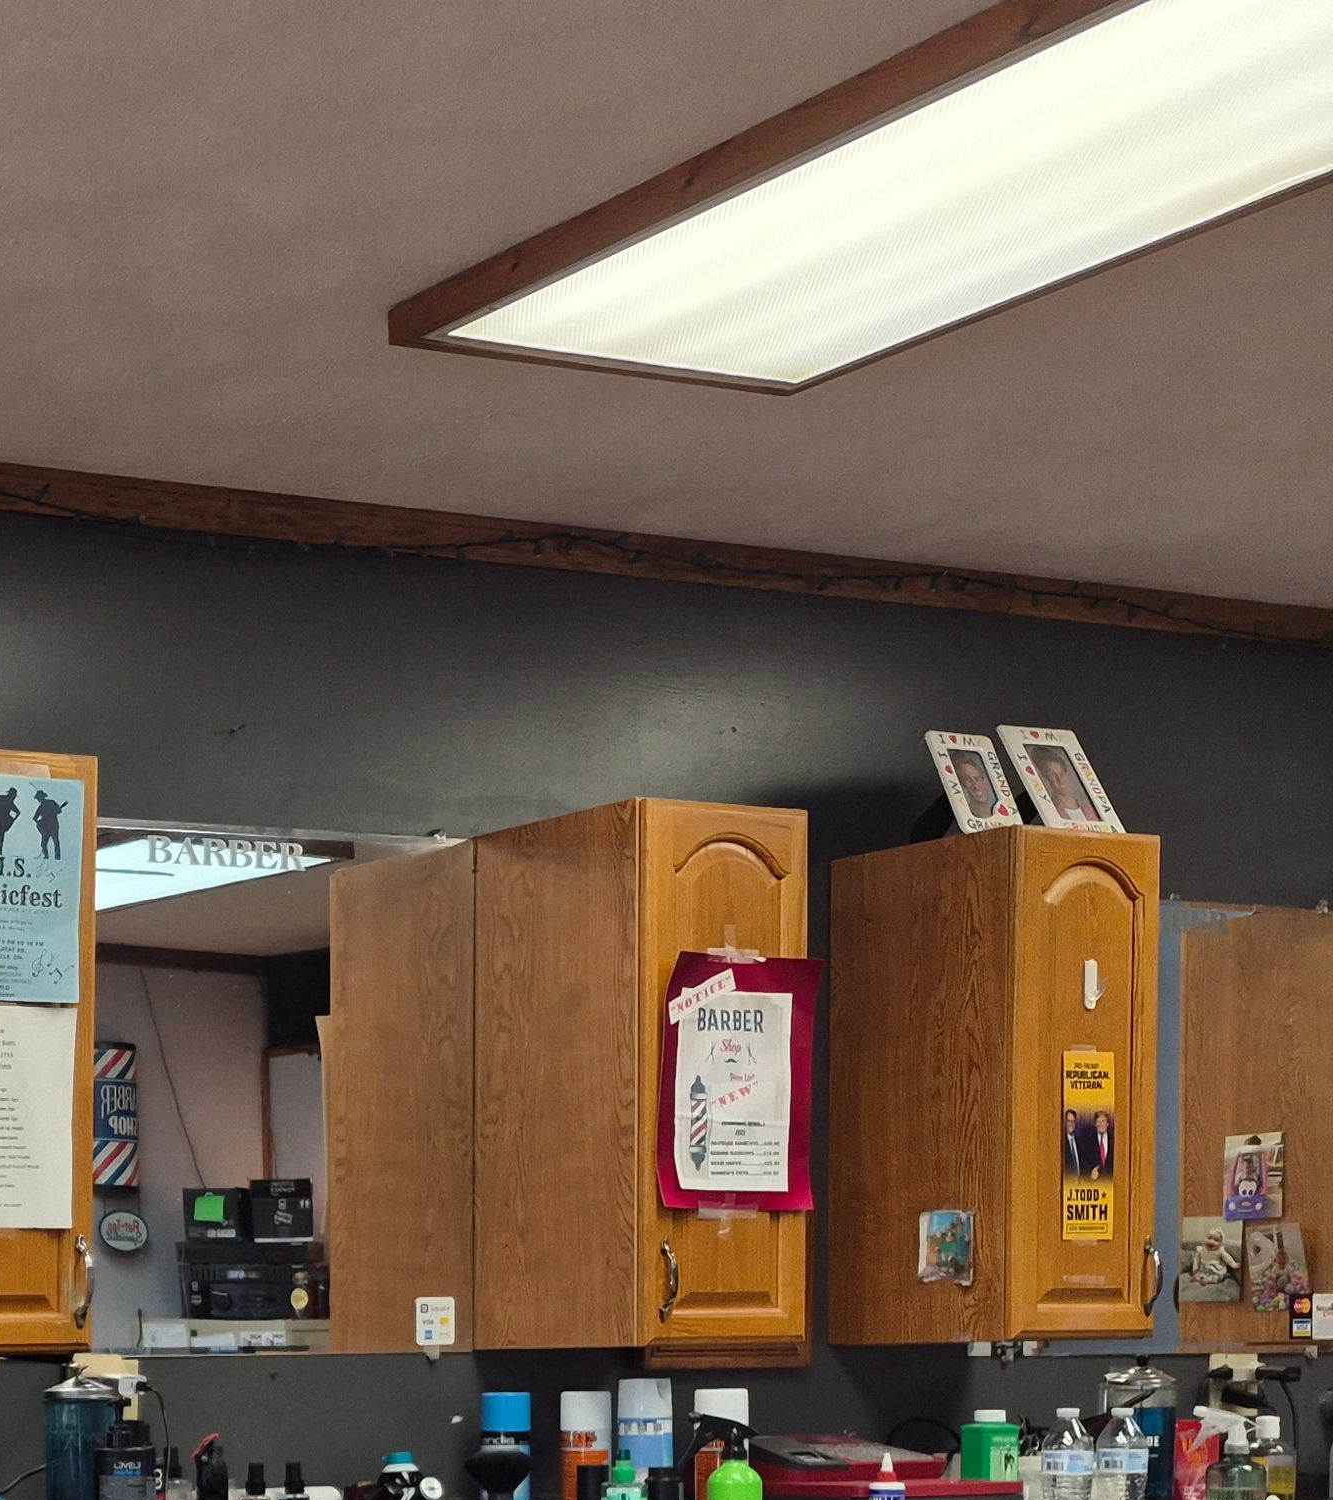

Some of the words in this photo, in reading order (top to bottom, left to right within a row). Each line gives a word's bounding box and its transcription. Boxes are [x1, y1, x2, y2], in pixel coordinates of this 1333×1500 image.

[966, 818, 1006, 830] GRAND
[147, 834, 307, 872] BARBER
[697, 1007, 765, 1034] BARBER
[719, 1038, 743, 1056] Shop
[1067, 1204, 1108, 1220] SMITH
